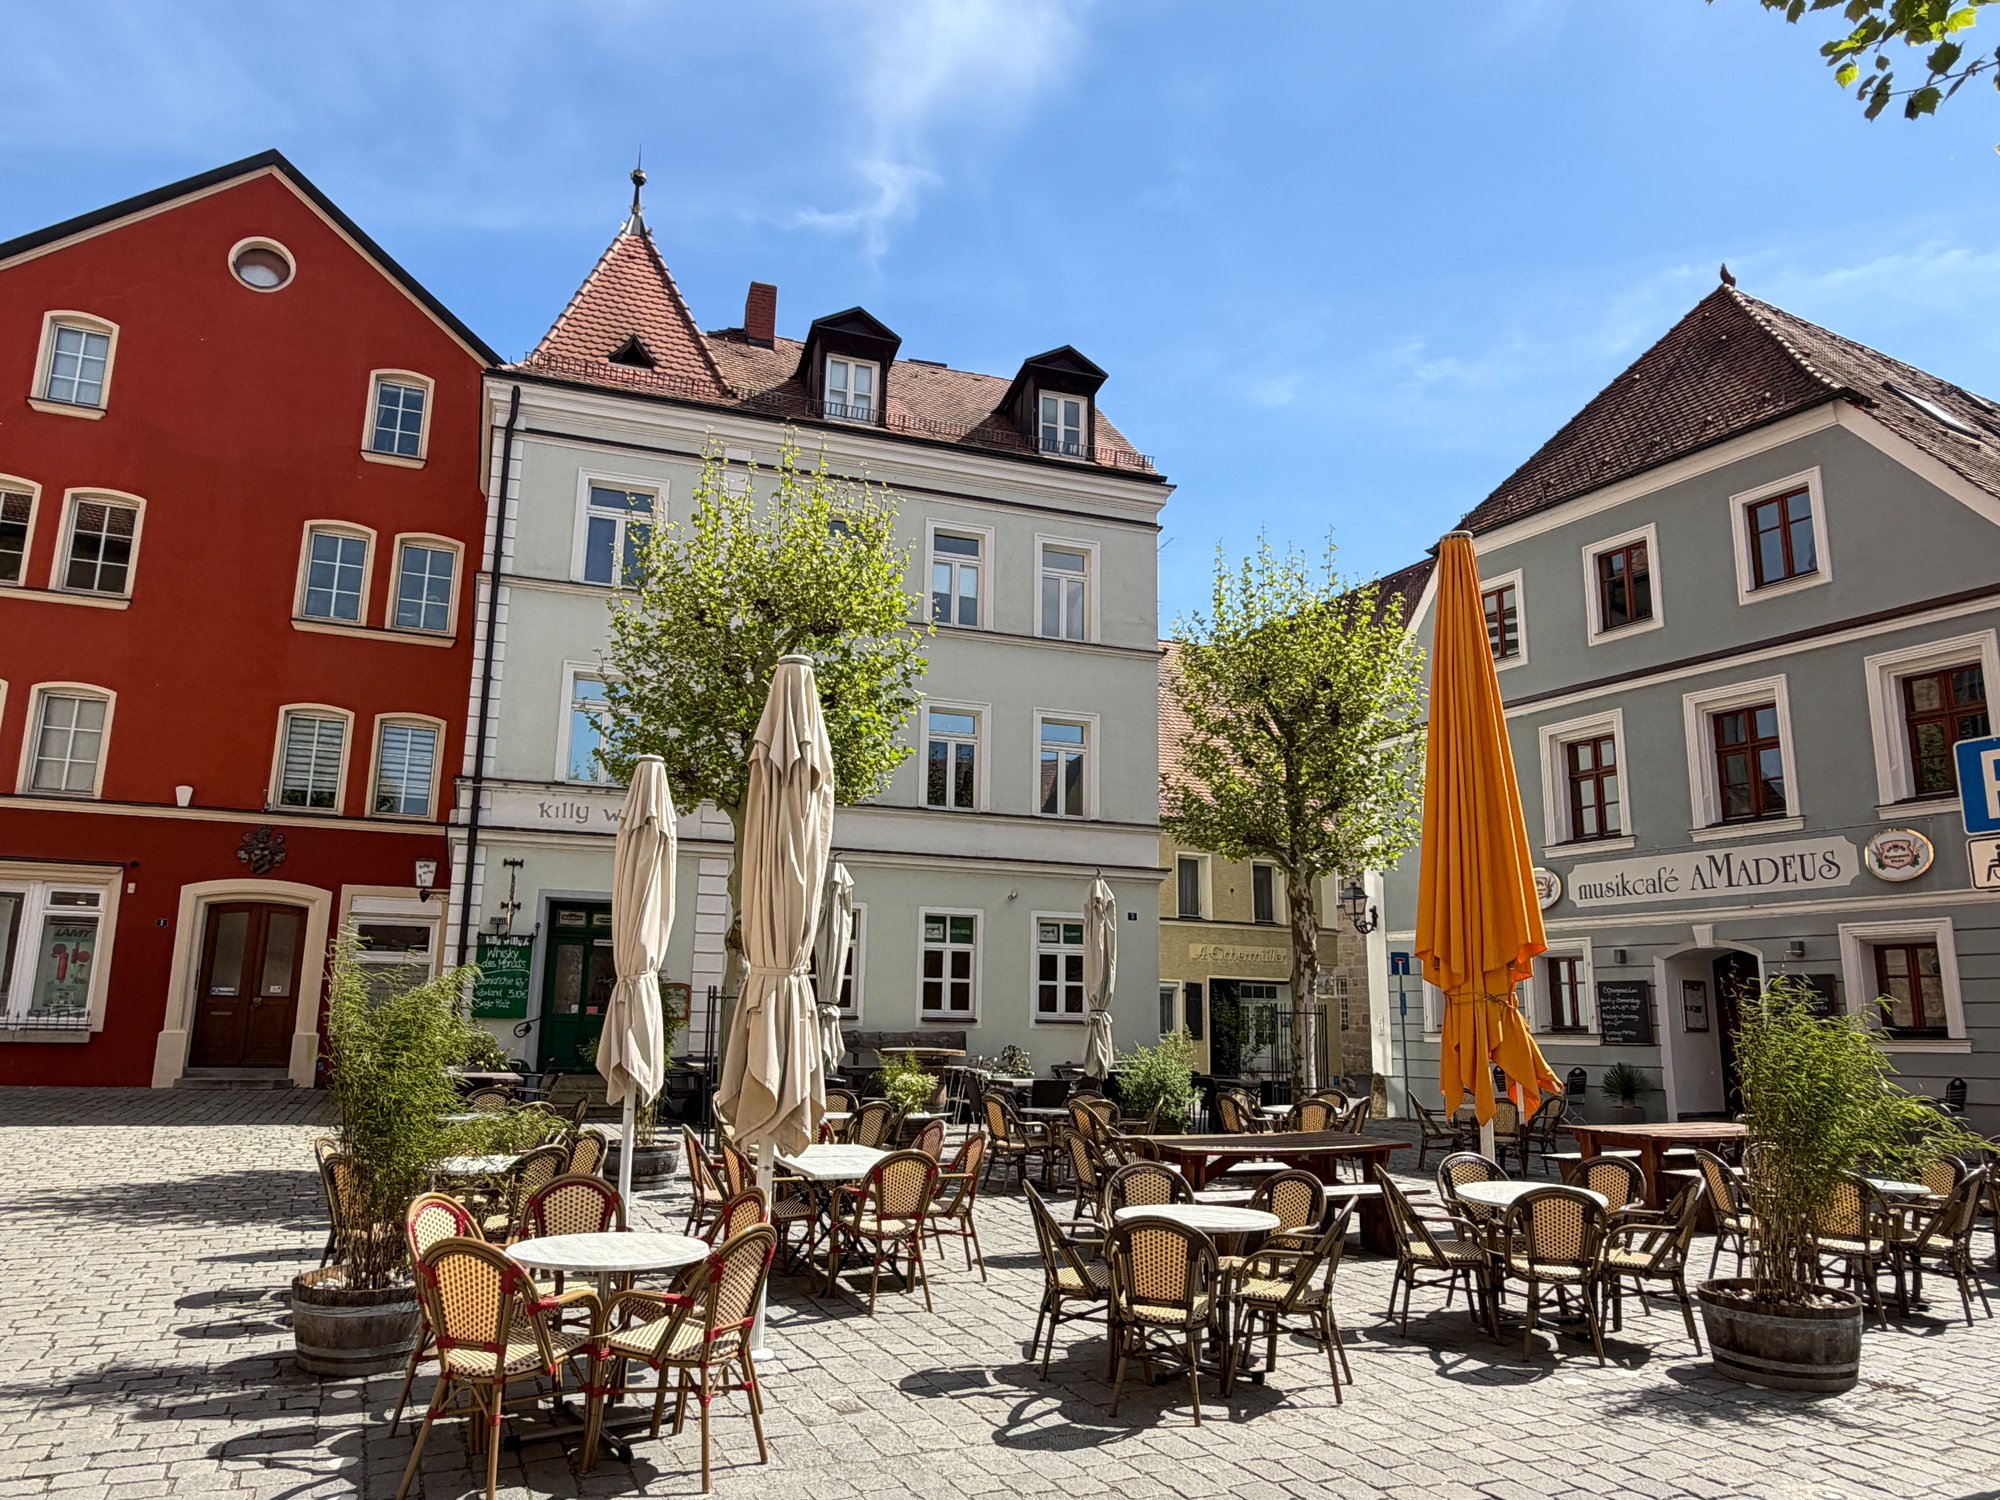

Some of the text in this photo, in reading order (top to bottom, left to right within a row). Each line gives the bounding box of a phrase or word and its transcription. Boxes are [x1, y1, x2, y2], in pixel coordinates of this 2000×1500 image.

[538, 801, 590, 824] killy
[1578, 850, 1841, 900] musikcafé AMADEUS
[55, 928, 93, 937] LAMY
[487, 946, 520, 961] Whisky
[481, 958, 497, 969] des
